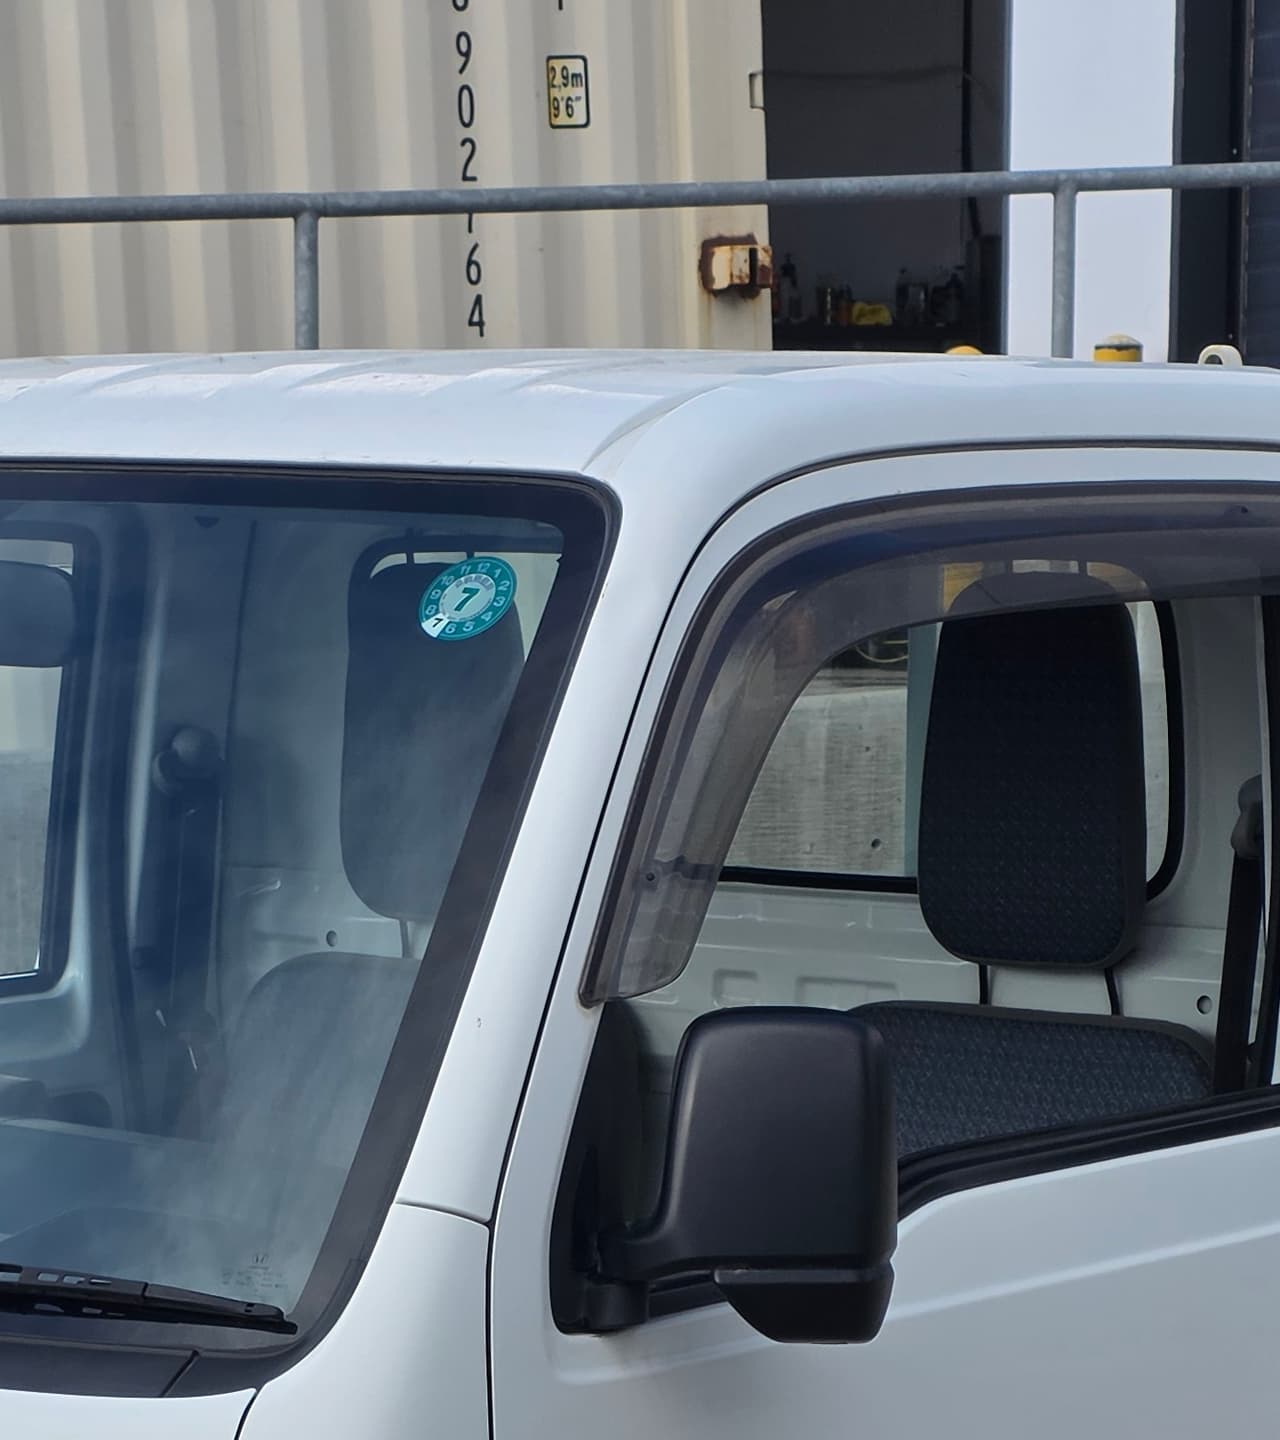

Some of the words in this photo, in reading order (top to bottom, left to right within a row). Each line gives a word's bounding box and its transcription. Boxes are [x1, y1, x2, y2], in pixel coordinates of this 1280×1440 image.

[498, 580, 509, 590] 2
[430, 589, 441, 599] 9
[454, 586, 481, 612] 7
[494, 597, 505, 606] 3
[426, 605, 436, 614] 8
[481, 612, 492, 621] 4
[432, 618, 443, 627] 7
[463, 622, 475, 631] 5
[445, 624, 456, 633] 6
